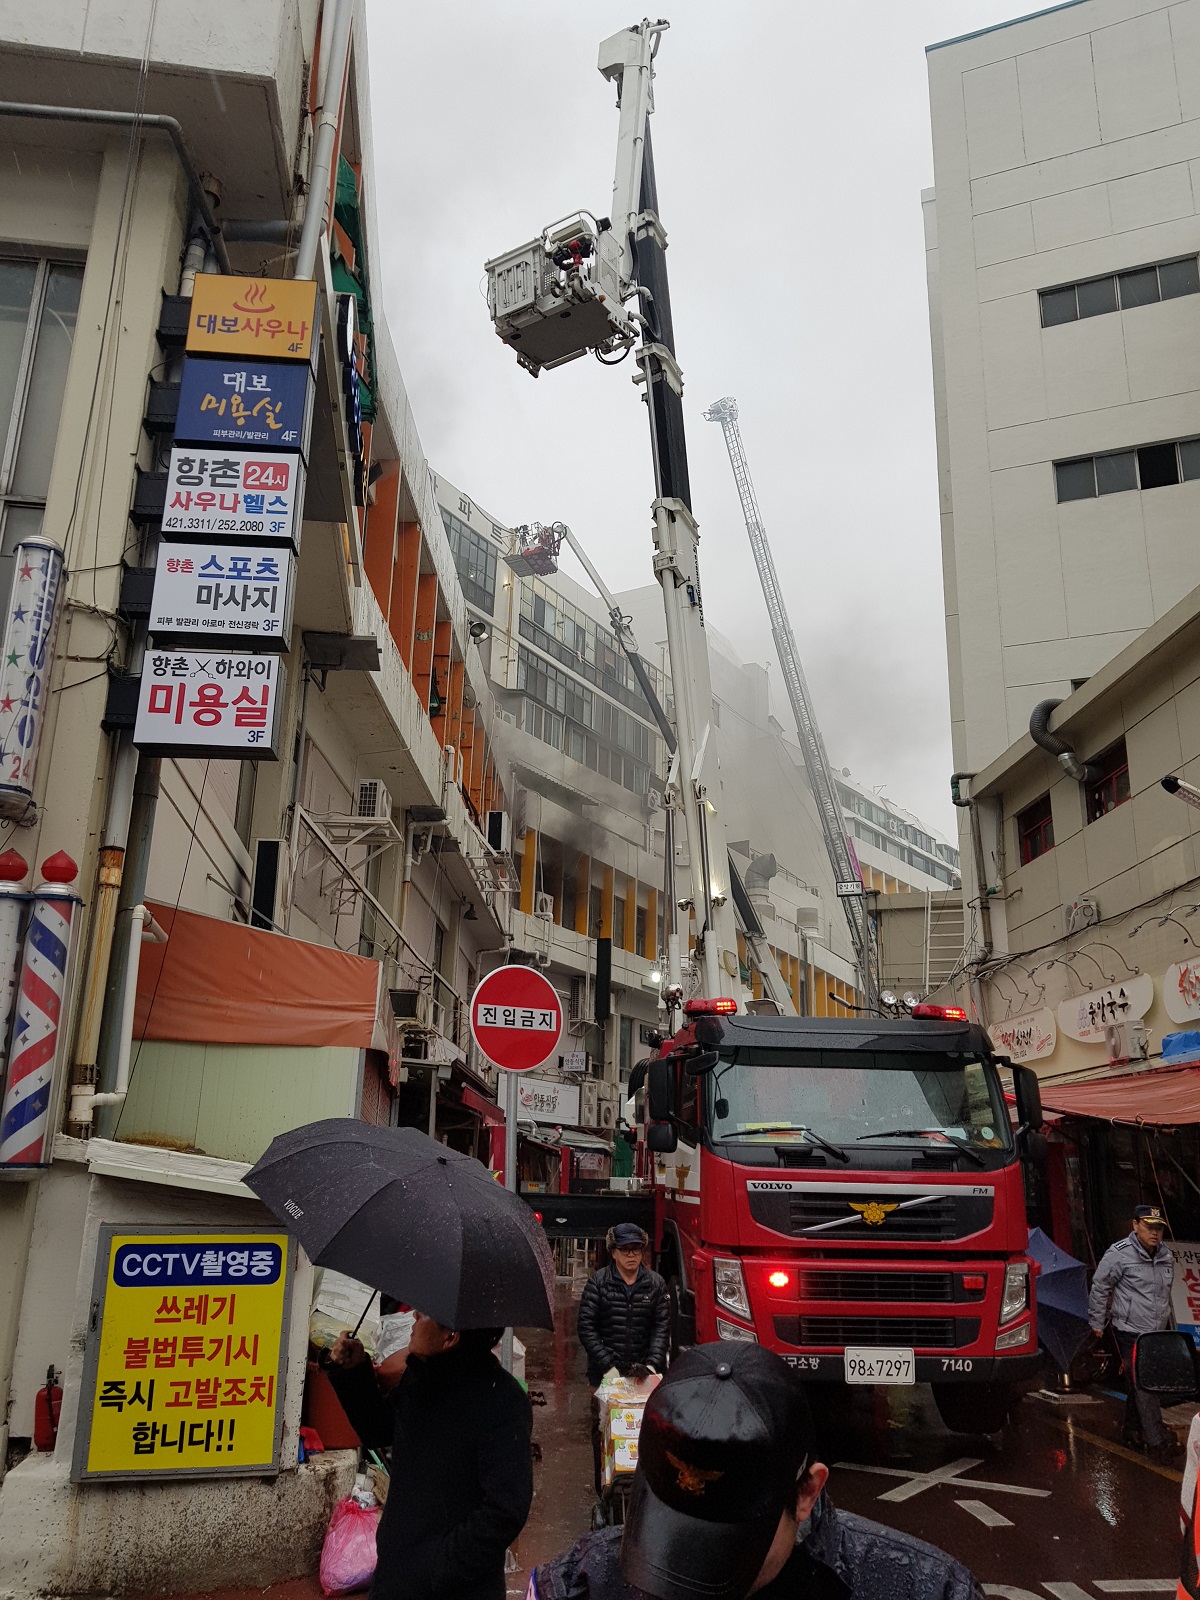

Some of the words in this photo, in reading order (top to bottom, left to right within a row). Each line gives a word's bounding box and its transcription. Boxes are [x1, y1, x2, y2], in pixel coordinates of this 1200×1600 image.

[196, 314, 309, 341] 대보사우나
[287, 342, 304, 353] 4F
[223, 371, 272, 394] 대보
[200, 393, 283, 430] 미용실
[281, 430, 298, 442] 4F
[175, 456, 241, 488] 향촌
[245, 465, 287, 488] 24시
[165, 517, 264, 533] 421.3311/252.2080
[269, 521, 287, 533] 3F
[166, 557, 195, 574] 향촌
[197, 554, 280, 582] 스포츠
[196, 583, 278, 614] 마사지
[156, 616, 174, 627] 피부
[175, 617, 199, 628] 발관리
[201, 618, 226, 629] 아로마
[262, 619, 280, 632] 3F
[151, 655, 190, 677] 향촌
[215, 658, 272, 680] 하와이
[147, 682, 270, 728] 미용실
[247, 729, 266, 743] 3F
[482, 1006, 553, 1030] 진입금지
[1088, 987, 1130, 1026] 중앙국수
[750, 1182, 793, 1191] VOLVO
[972, 1187, 989, 1195] FM
[284, 1199, 304, 1220] VOGUE
[121, 1250, 275, 1278] CCTV촬영중
[153, 1293, 237, 1326] 쓰레기
[122, 1334, 260, 1370] 불법투기시
[782, 1356, 821, 1370] 구소방
[848, 1359, 911, 1377] 98소7297
[941, 1359, 973, 1372] 7140
[98, 1378, 156, 1413] 즉시
[164, 1374, 275, 1410] 고발조치
[131, 1418, 236, 1455] 합니다!!
